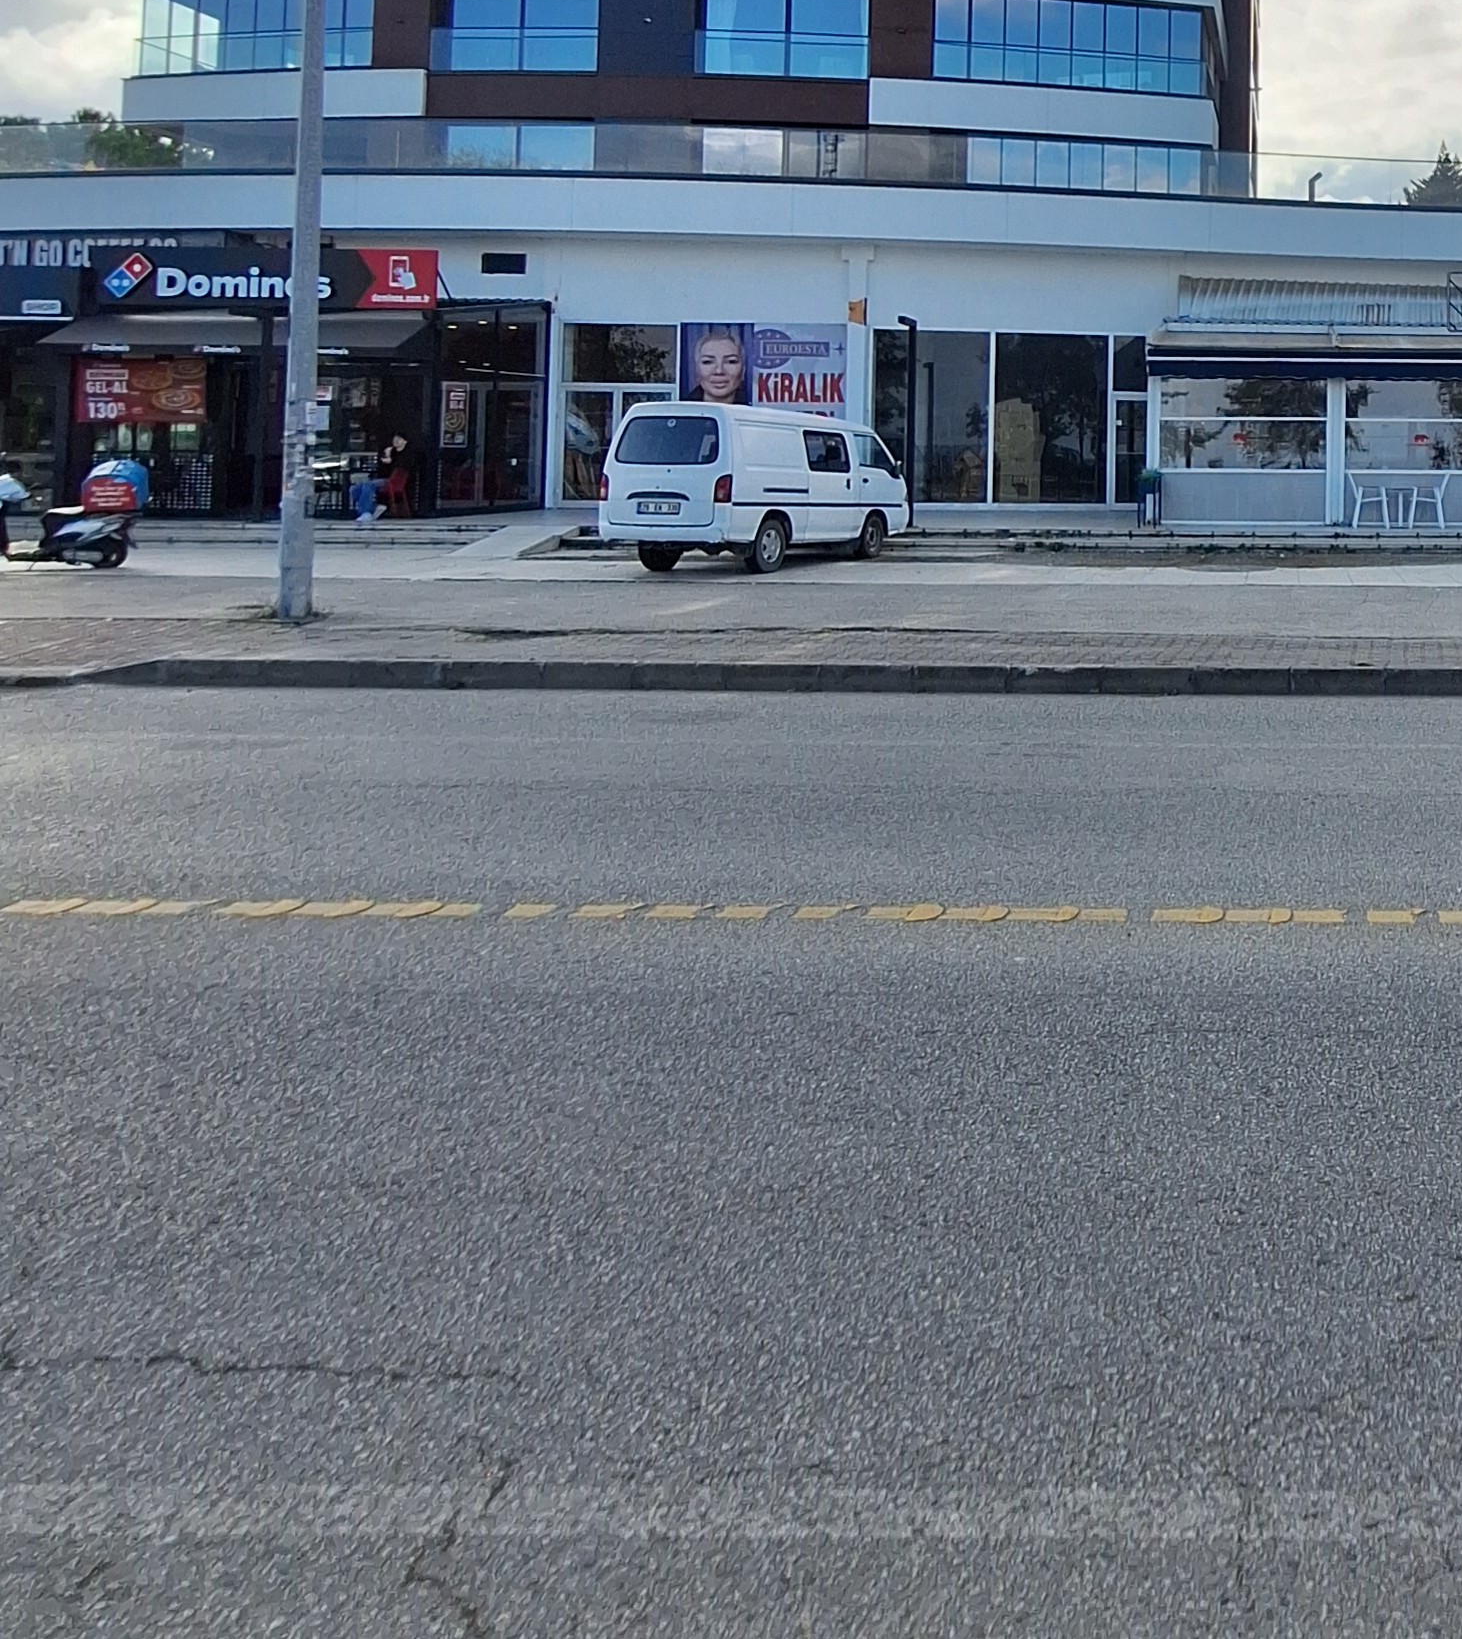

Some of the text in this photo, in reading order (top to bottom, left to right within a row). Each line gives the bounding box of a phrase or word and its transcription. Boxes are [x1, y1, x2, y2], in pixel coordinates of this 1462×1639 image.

[34, 239, 64, 268] GO
[765, 343, 828, 355] EUROESTA
[85, 381, 128, 394] GEL-AL
[88, 402, 118, 419] 130
